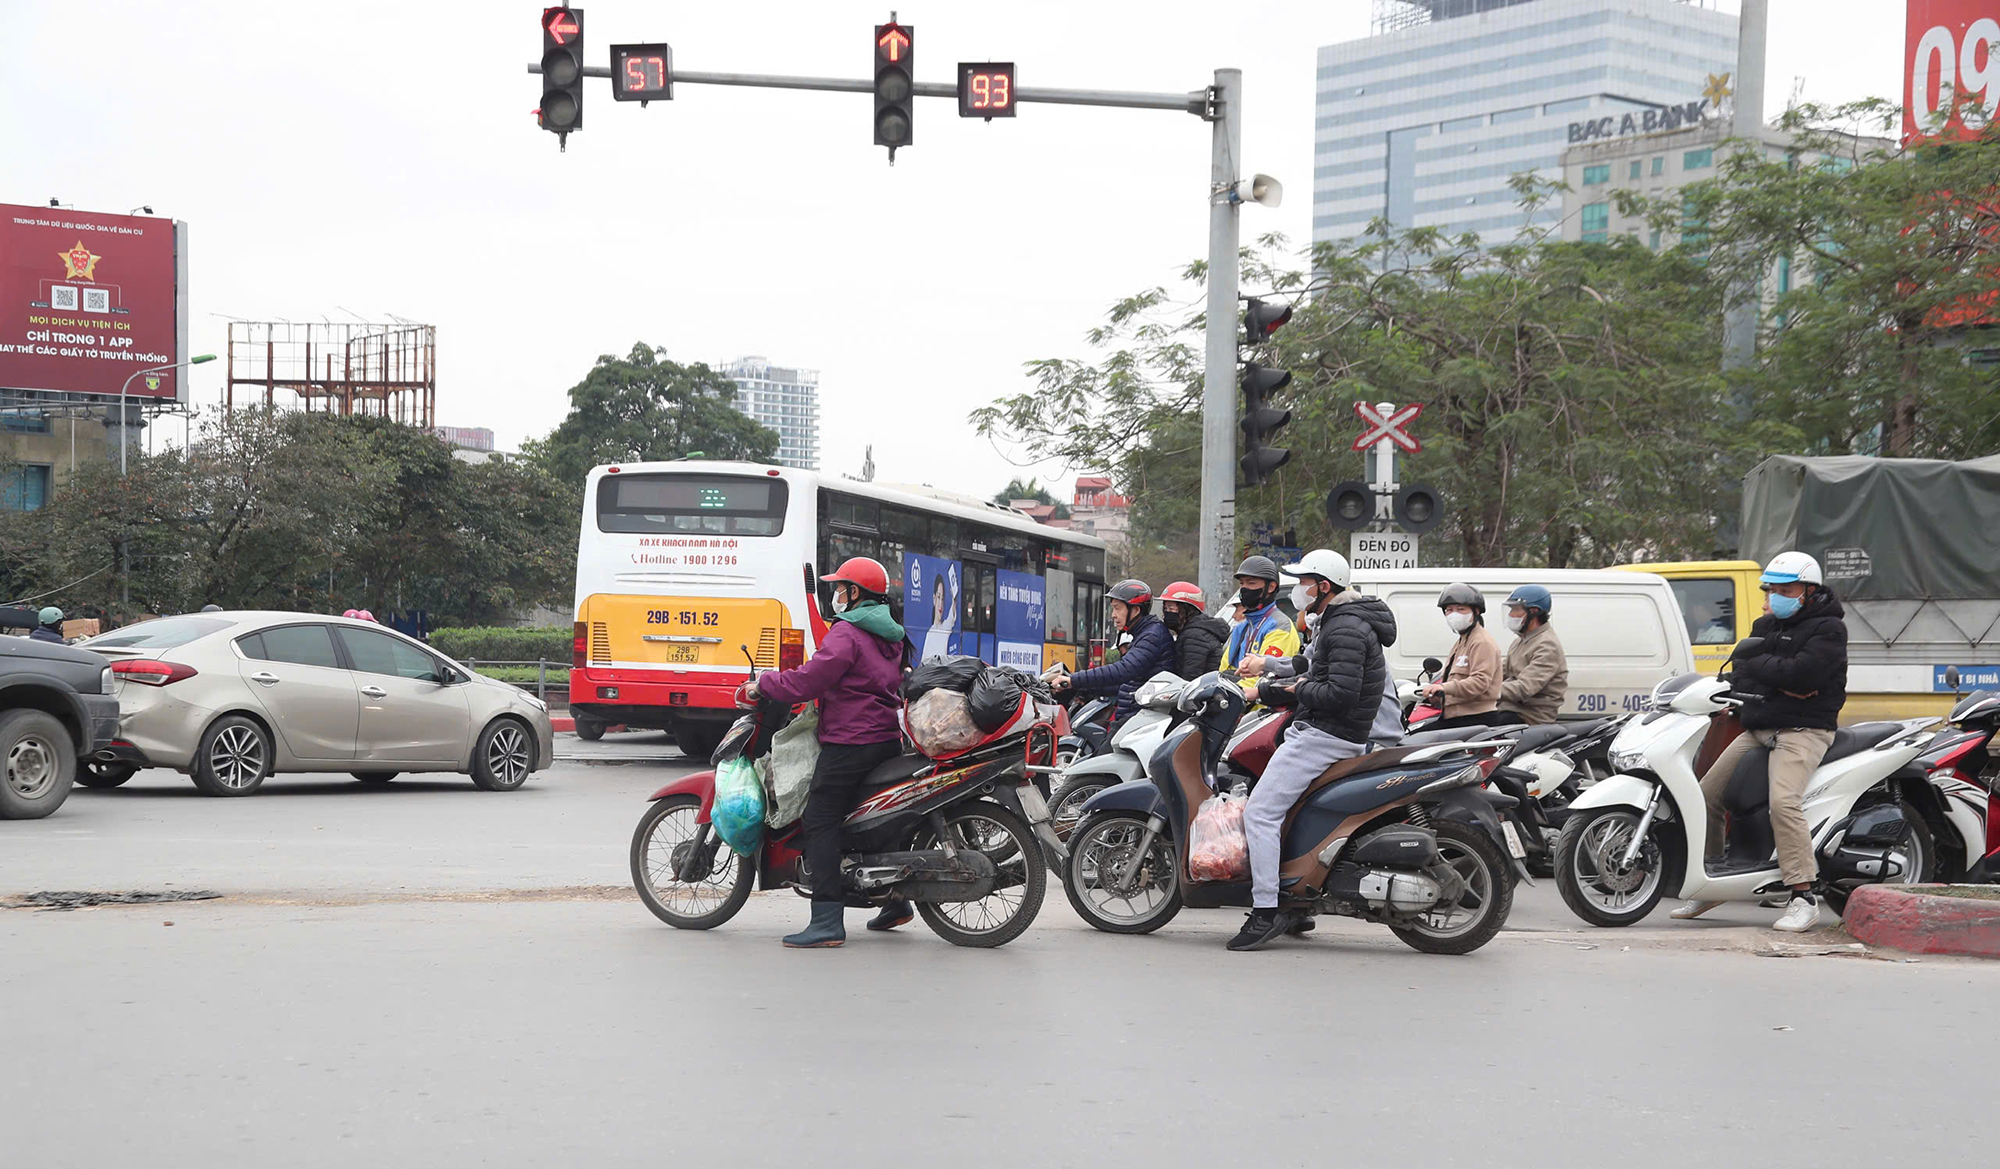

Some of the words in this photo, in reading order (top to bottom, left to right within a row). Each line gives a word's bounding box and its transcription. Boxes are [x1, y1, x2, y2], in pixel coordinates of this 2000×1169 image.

[626, 57, 664, 90] 57
[972, 74, 1009, 108] 93
[1568, 117, 1613, 143] BAC
[1619, 113, 1637, 135] A
[1642, 99, 1709, 131] BANK
[13, 217, 36, 225] TRUNG
[29, 316, 49, 325] MỌI
[51, 317, 75, 326] DỊCH
[77, 319, 90, 328] VỤ
[92, 320, 111, 329] TIỆN
[114, 321, 131, 330] ÍCH
[26, 329, 50, 342] CHỈ
[52, 332, 96, 345] TRONG
[99, 336, 104, 346] 1
[109, 336, 133, 348] APP
[16, 344, 35, 354] THẾ
[36, 345, 58, 355] CÁC
[60, 347, 84, 357] GIẤY
[85, 348, 98, 358] TỜ
[135, 352, 168, 363] THỐNG
[651, 538, 661, 546] XE
[723, 538, 738, 550] NỘI
[1359, 535, 1387, 551] ĐÈN
[1390, 534, 1410, 552] ĐỎ
[640, 554, 678, 564] Hotline
[684, 555, 707, 565] 1900
[711, 555, 737, 565] 1296
[1354, 555, 1391, 569] DỪNG
[647, 610, 669, 624] 29B
[1965, 674, 1976, 686] BỊ
[1978, 672, 1999, 684] NHÀ
[1578, 694, 1606, 712] 29D
